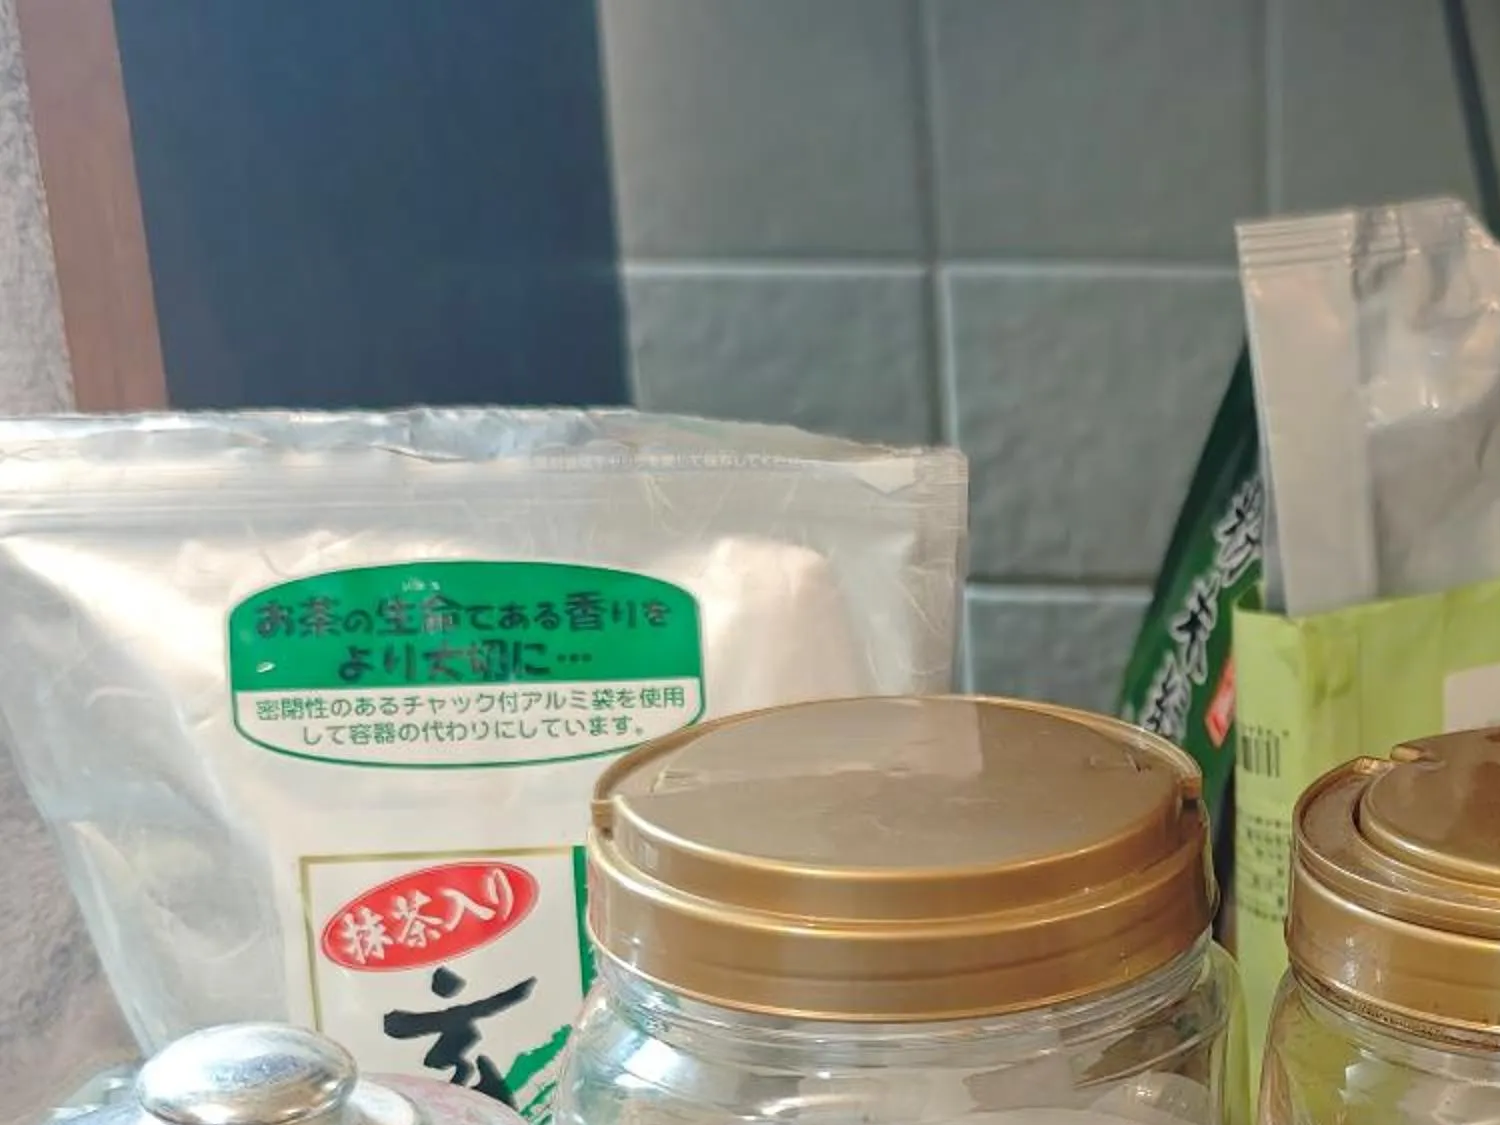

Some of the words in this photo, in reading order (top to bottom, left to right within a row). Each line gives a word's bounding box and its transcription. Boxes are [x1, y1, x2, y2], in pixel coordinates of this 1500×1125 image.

[255, 687, 685, 720] 密閉性のあるチャック付アルミ袋を使用
[303, 715, 644, 746] して容器の代わりにしています。
[341, 868, 515, 964] 抹茶入り
